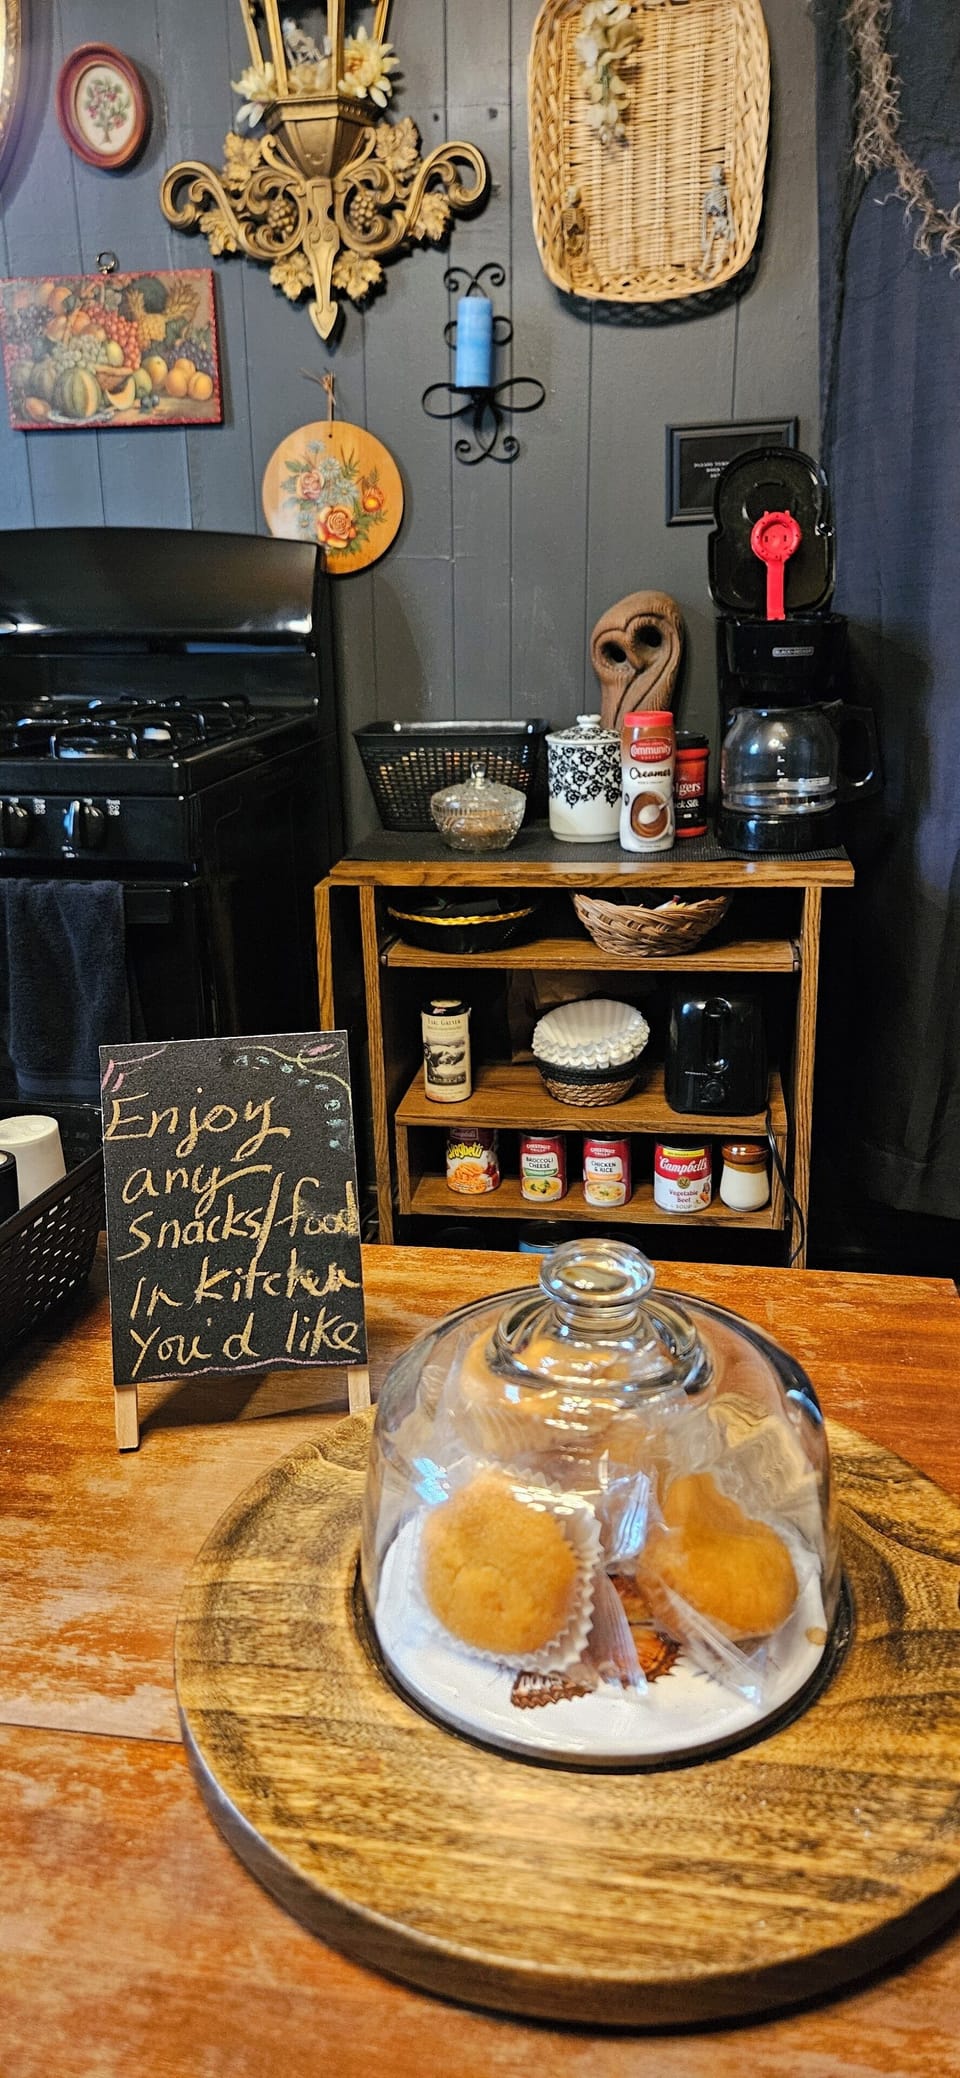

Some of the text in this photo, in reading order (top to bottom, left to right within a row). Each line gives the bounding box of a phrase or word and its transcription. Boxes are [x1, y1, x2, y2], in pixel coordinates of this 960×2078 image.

[630, 743, 672, 758] Community
[629, 766, 672, 780] Creamer
[672, 782, 701, 796] lgers
[104, 1087, 291, 1162] Enjoy
[591, 1160, 616, 1168] CHICKEN
[659, 1156, 707, 1175] Campbell's
[122, 1164, 272, 1216] any
[668, 1188, 698, 1197] Vegetable
